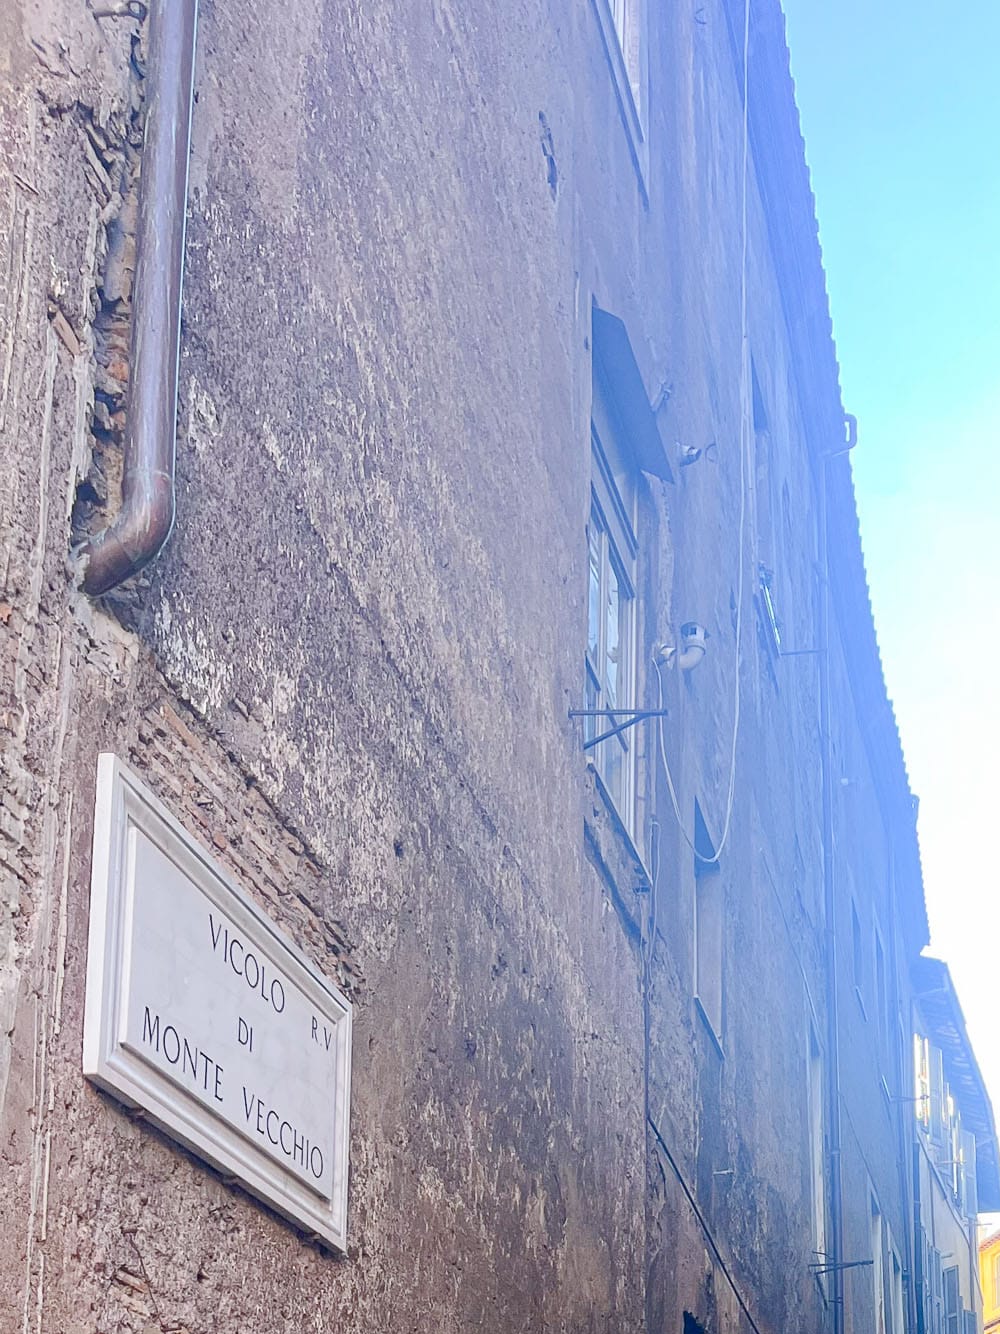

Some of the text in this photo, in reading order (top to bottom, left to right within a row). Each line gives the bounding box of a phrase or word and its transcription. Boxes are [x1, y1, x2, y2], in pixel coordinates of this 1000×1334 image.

[209, 913, 285, 1013] VICOLO
[238, 1016, 253, 1053] DI
[143, 1006, 324, 1179] MONTE VECCHIO
